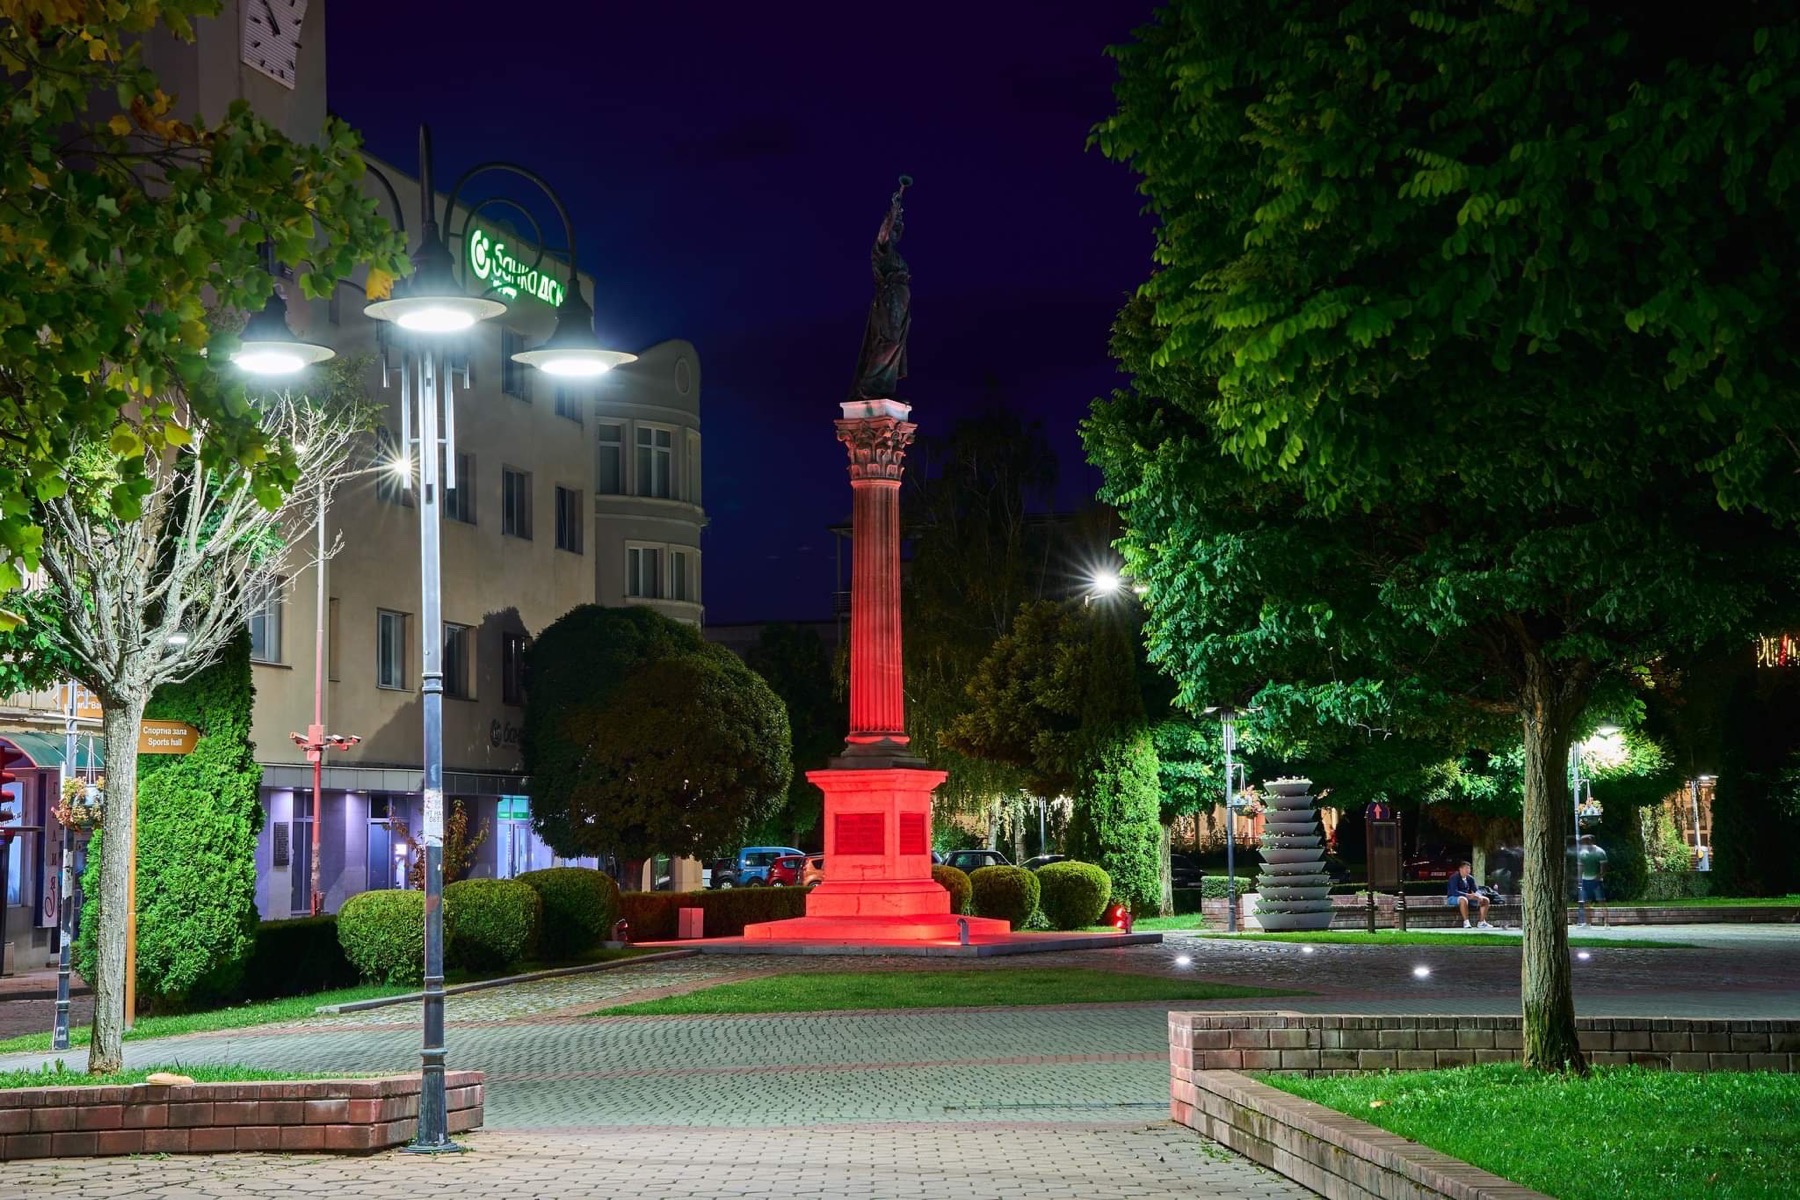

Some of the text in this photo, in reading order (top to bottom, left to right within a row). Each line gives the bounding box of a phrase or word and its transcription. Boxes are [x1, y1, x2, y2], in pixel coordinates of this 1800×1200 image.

[142, 726, 172, 736] Спортна
[147, 737, 183, 747] Sports hall
